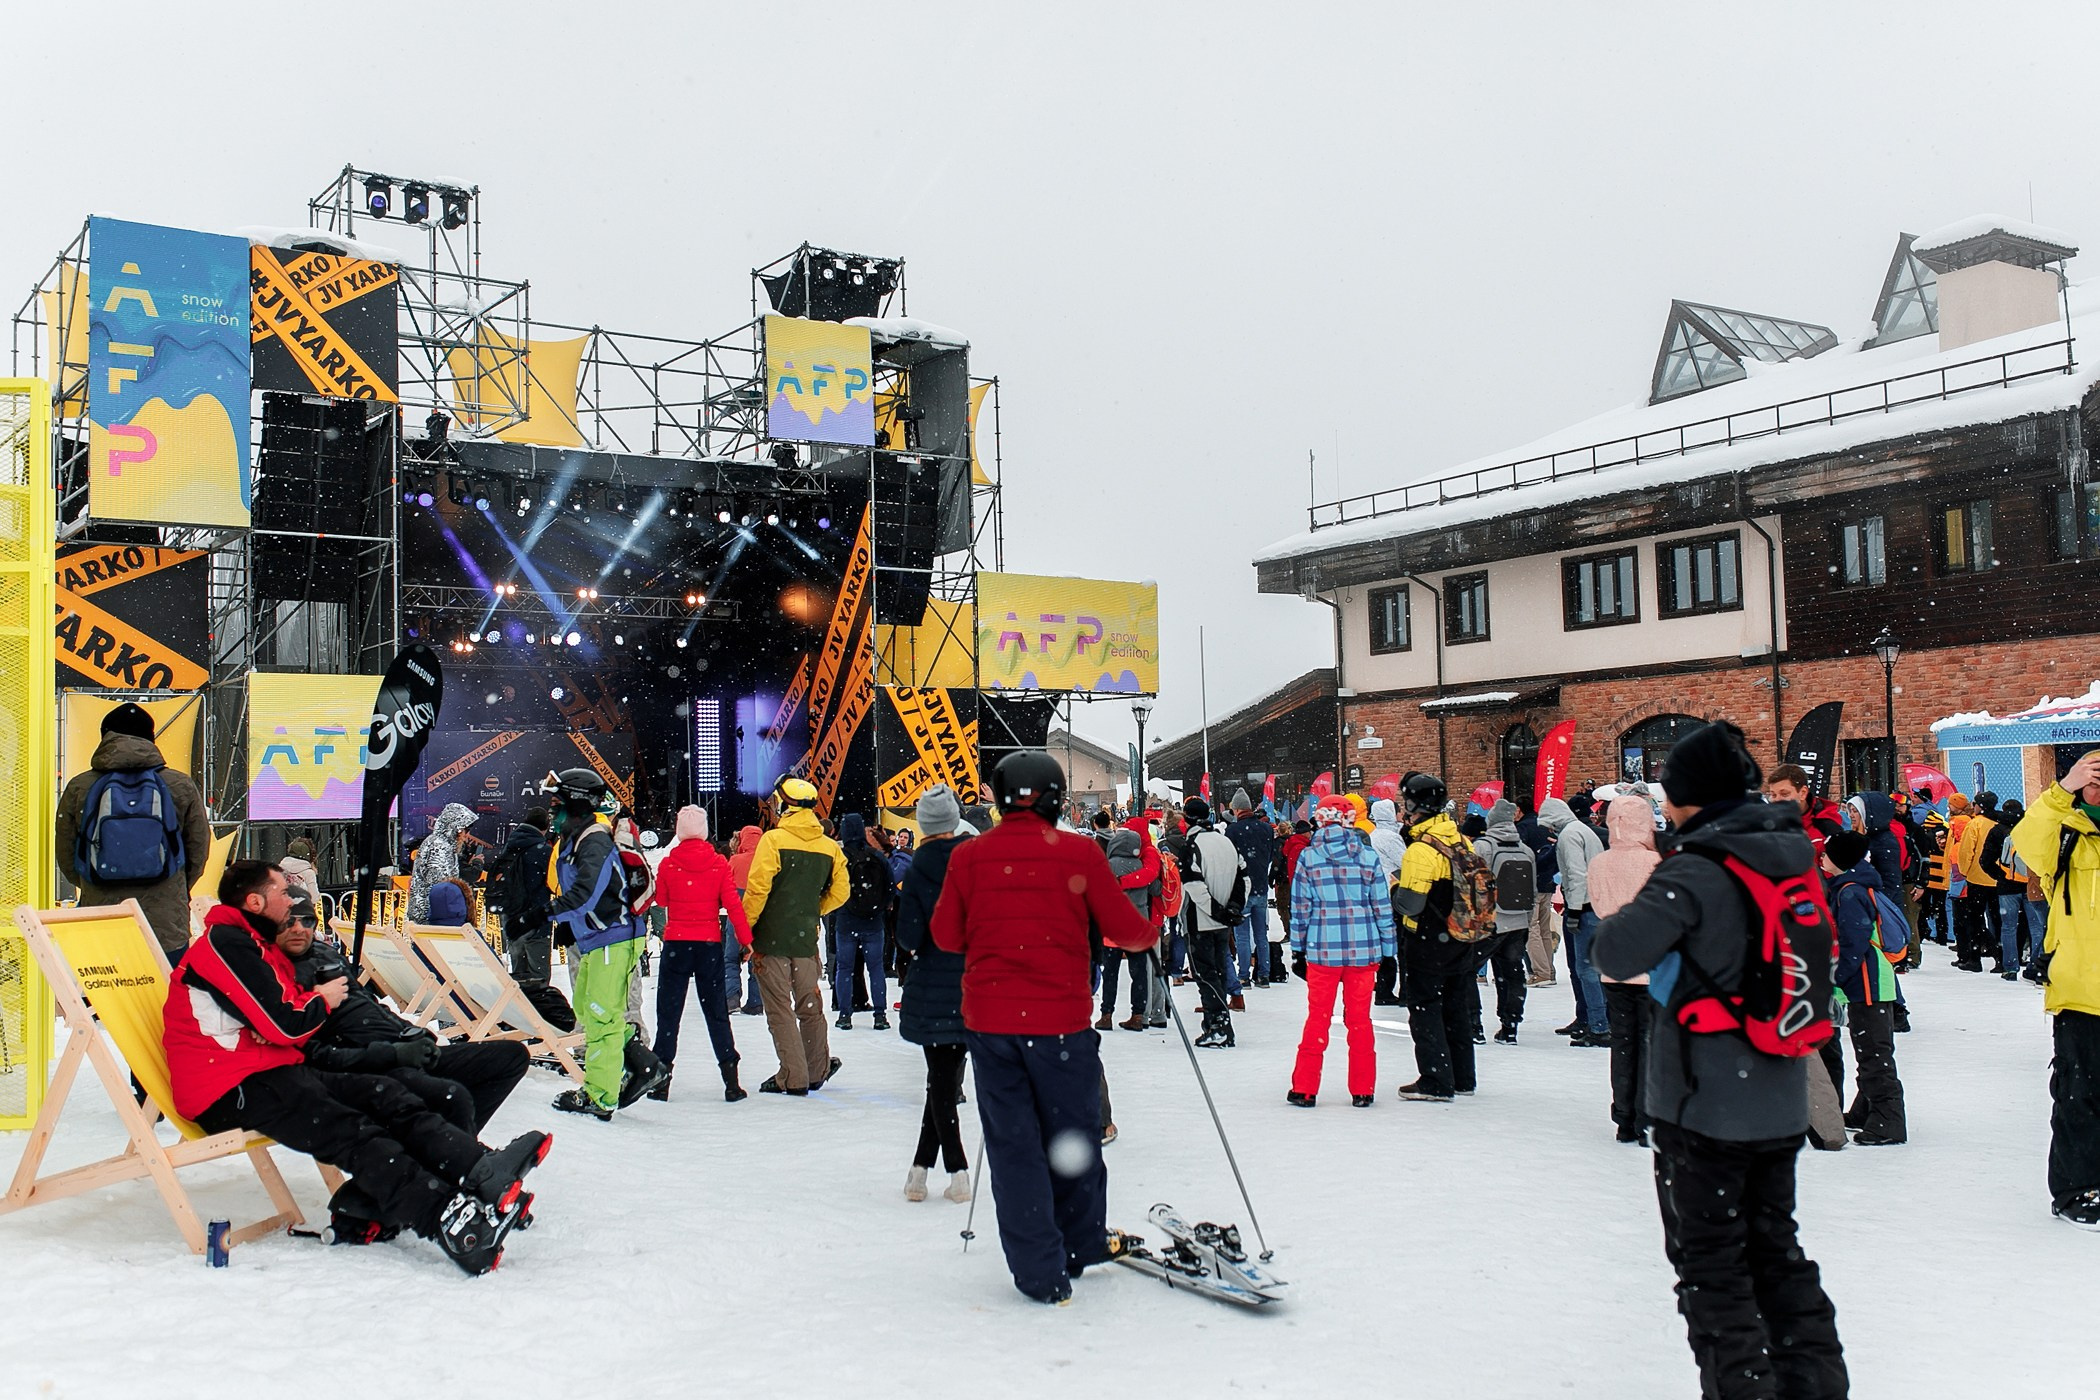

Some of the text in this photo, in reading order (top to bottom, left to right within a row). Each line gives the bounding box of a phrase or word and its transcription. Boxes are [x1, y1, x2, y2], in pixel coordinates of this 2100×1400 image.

[182, 293, 223, 309] snow
[317, 280, 343, 305] JV
[182, 310, 239, 328] edition
[776, 361, 868, 399] AFP
[55, 546, 145, 592] ARKO
[829, 625, 844, 661] JV
[838, 547, 869, 627] YARKO
[55, 603, 173, 689] ARKO
[996, 612, 1103, 655] AFP
[1110, 632, 1139, 643] snow
[1110, 645, 1150, 659] edition
[406, 659, 436, 687] SAMSUNG
[775, 688, 799, 732] YARKO
[842, 706, 859, 733] JV
[365, 702, 436, 770] Galaxy
[429, 767, 456, 788] YARKO
[462, 757, 472, 768] JV
[471, 742, 497, 761] YARKO
[577, 738, 599, 764] YARKO
[600, 765, 611, 776] JV
[608, 775, 628, 798] YARKO
[1816, 768, 1825, 789] CLUB
[480, 790, 504, 798] Билайн
[889, 778, 909, 801] JV
